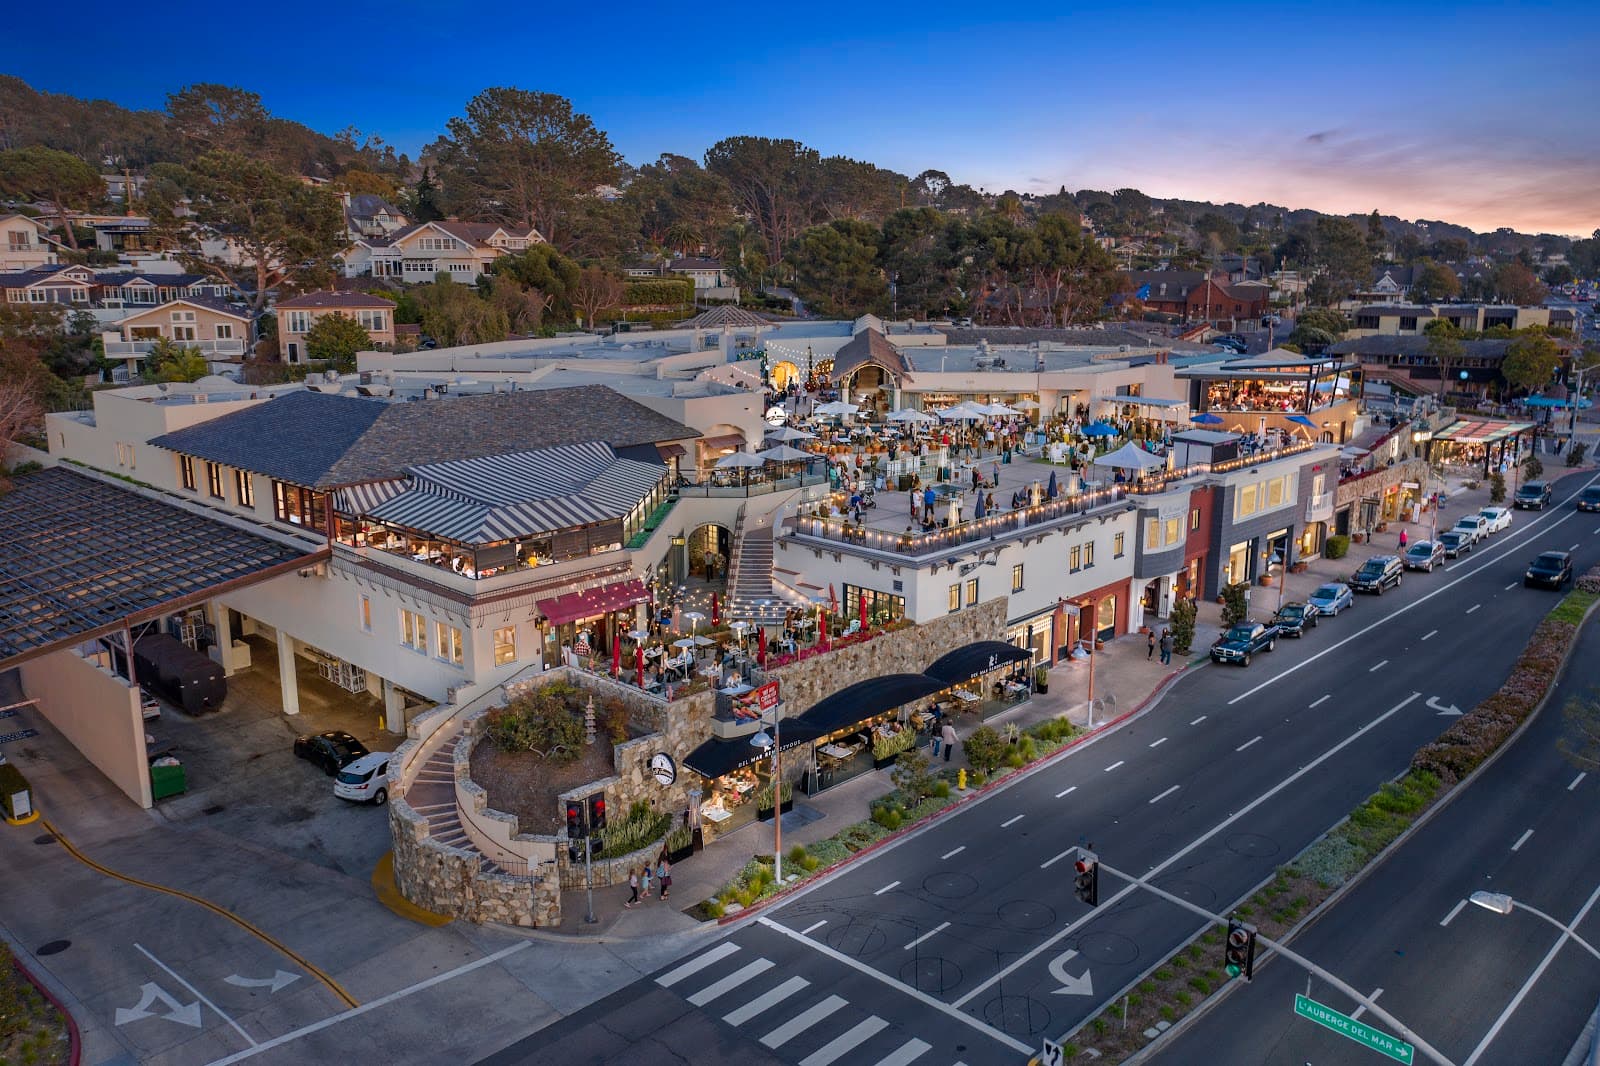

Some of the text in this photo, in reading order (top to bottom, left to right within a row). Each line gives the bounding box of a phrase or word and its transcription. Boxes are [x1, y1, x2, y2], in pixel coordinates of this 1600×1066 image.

[738, 759, 749, 768] DEL
[750, 754, 763, 763] MAR
[1298, 1000, 1393, 1050] L'AUBERGE DEL MAR
